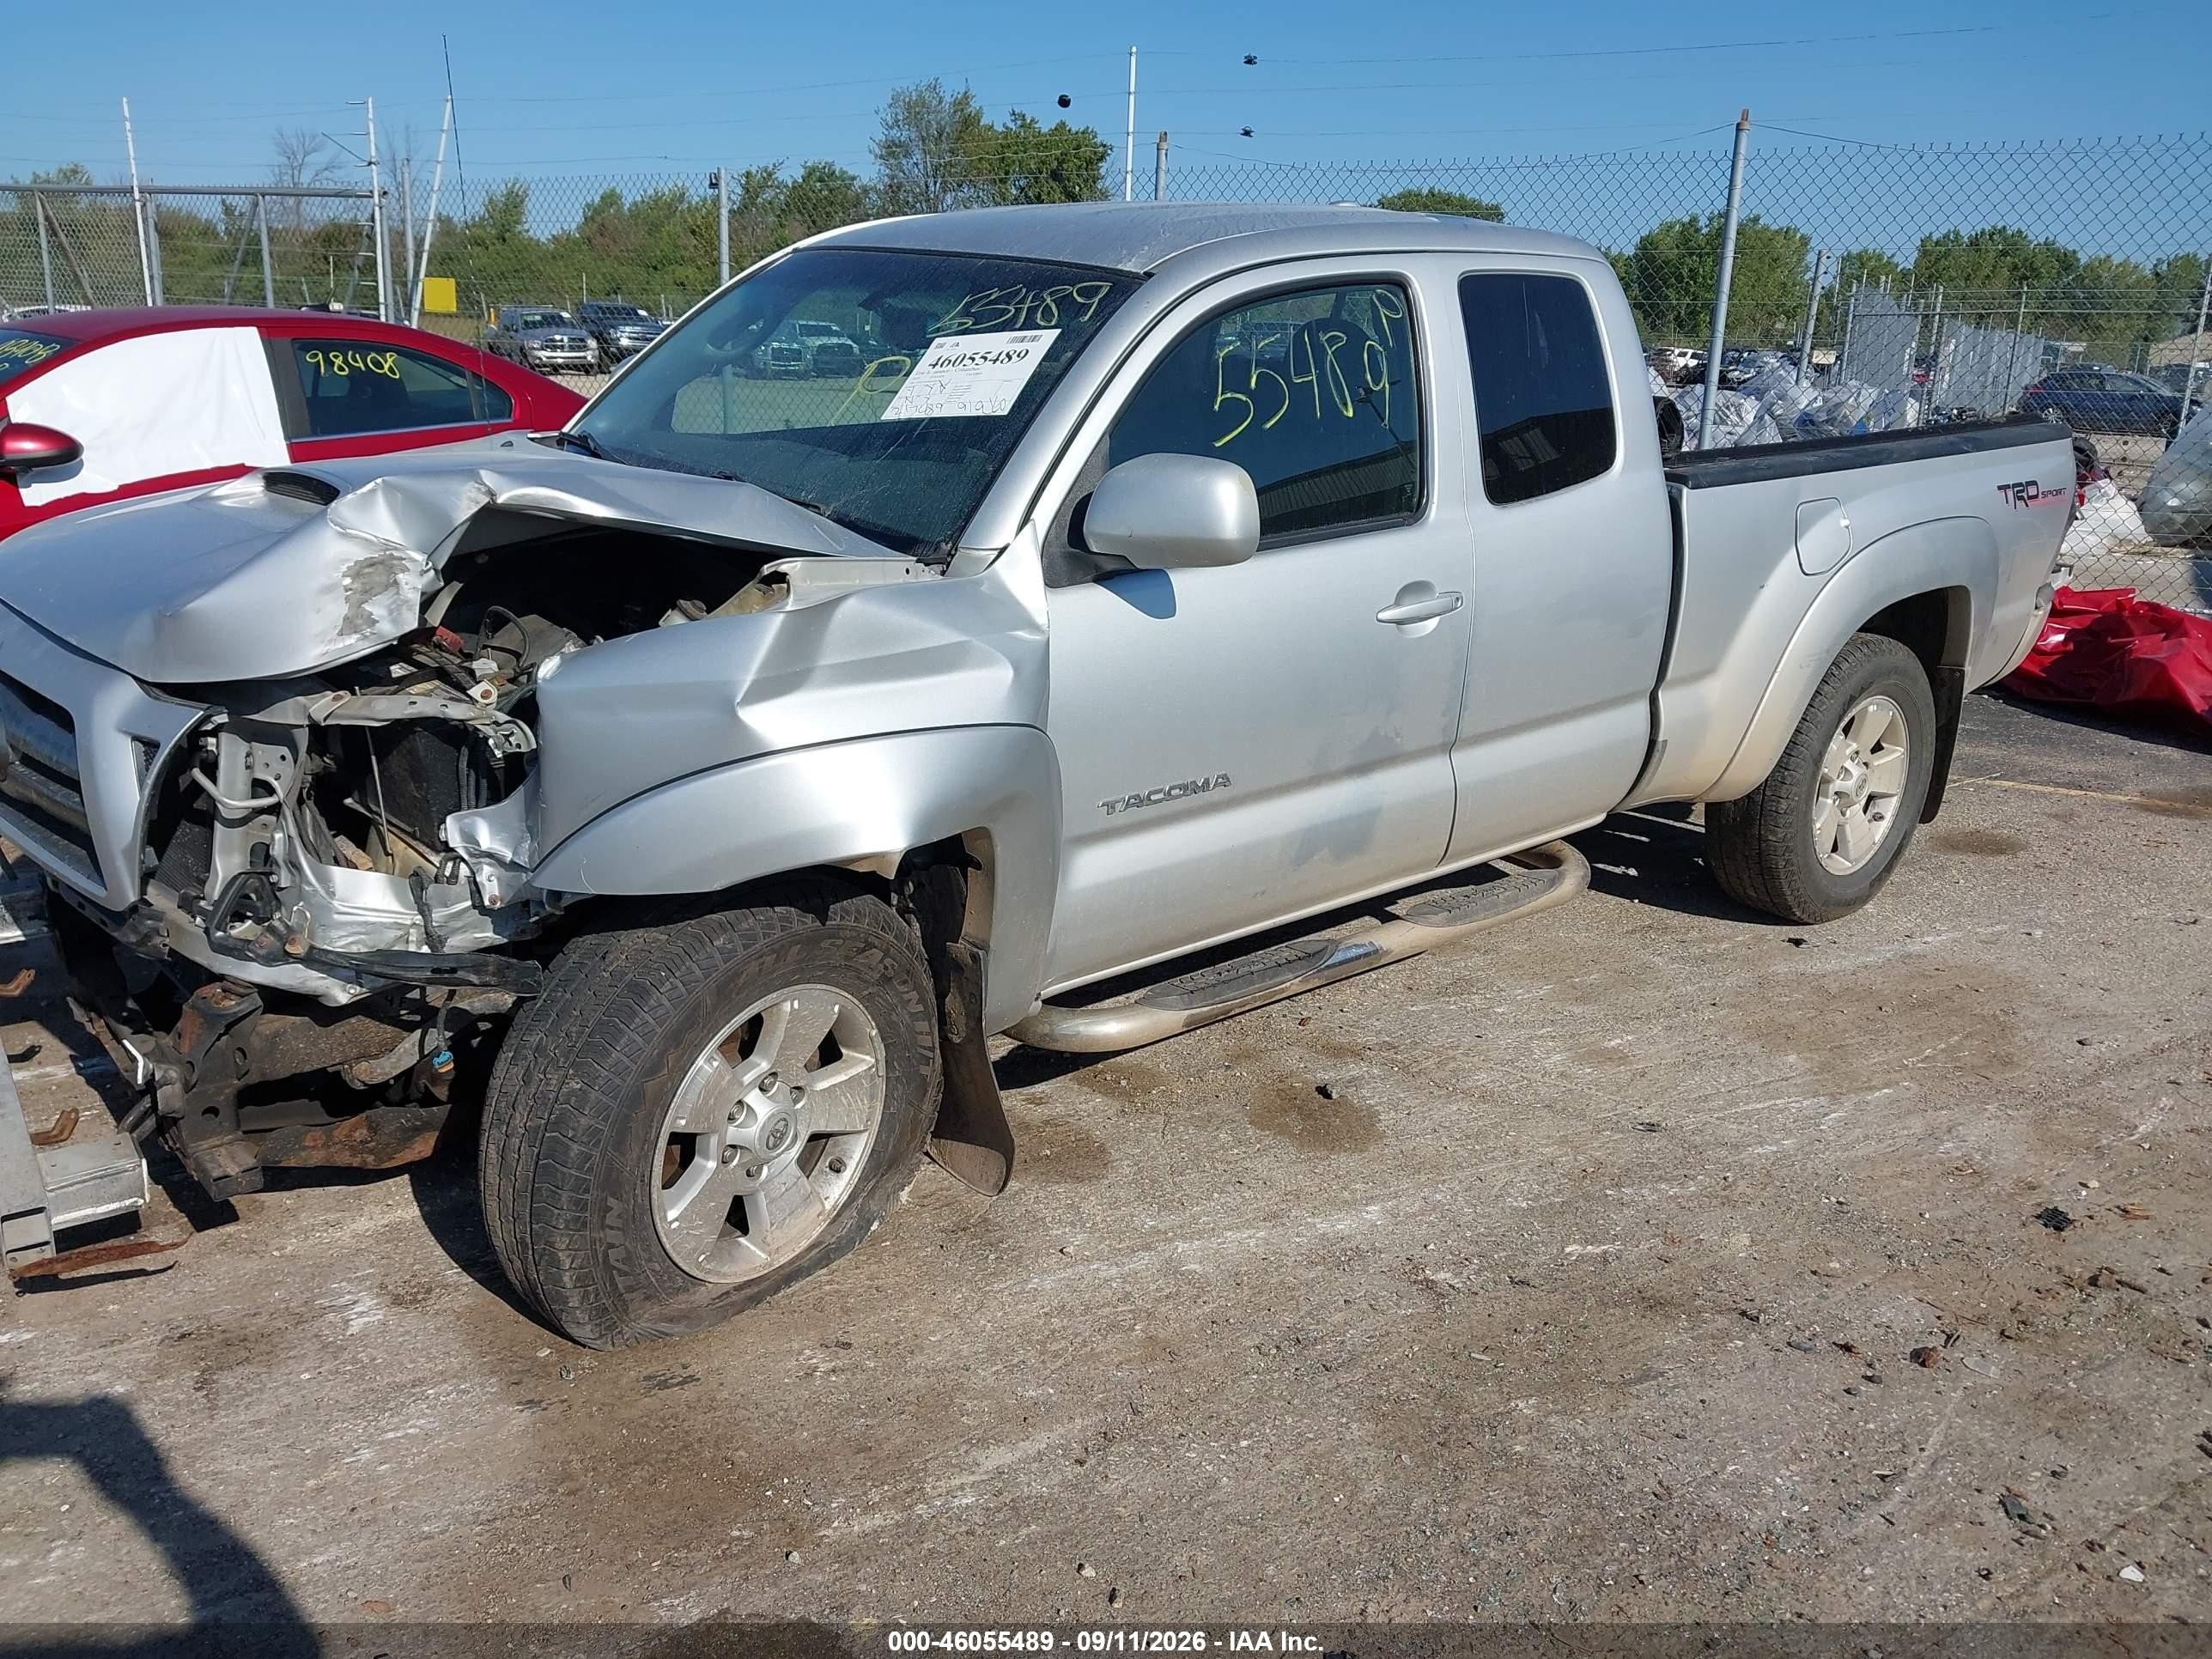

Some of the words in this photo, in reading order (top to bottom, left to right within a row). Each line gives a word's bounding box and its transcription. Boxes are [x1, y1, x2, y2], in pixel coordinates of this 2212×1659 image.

[306, 350, 401, 379] 98408
[927, 347, 1030, 371] 46055489
[1212, 329, 1390, 447] 55489
[1996, 479, 2039, 510] TRD
[2040, 488, 2067, 499] SPORT
[1097, 772, 1232, 816] TACOMA
